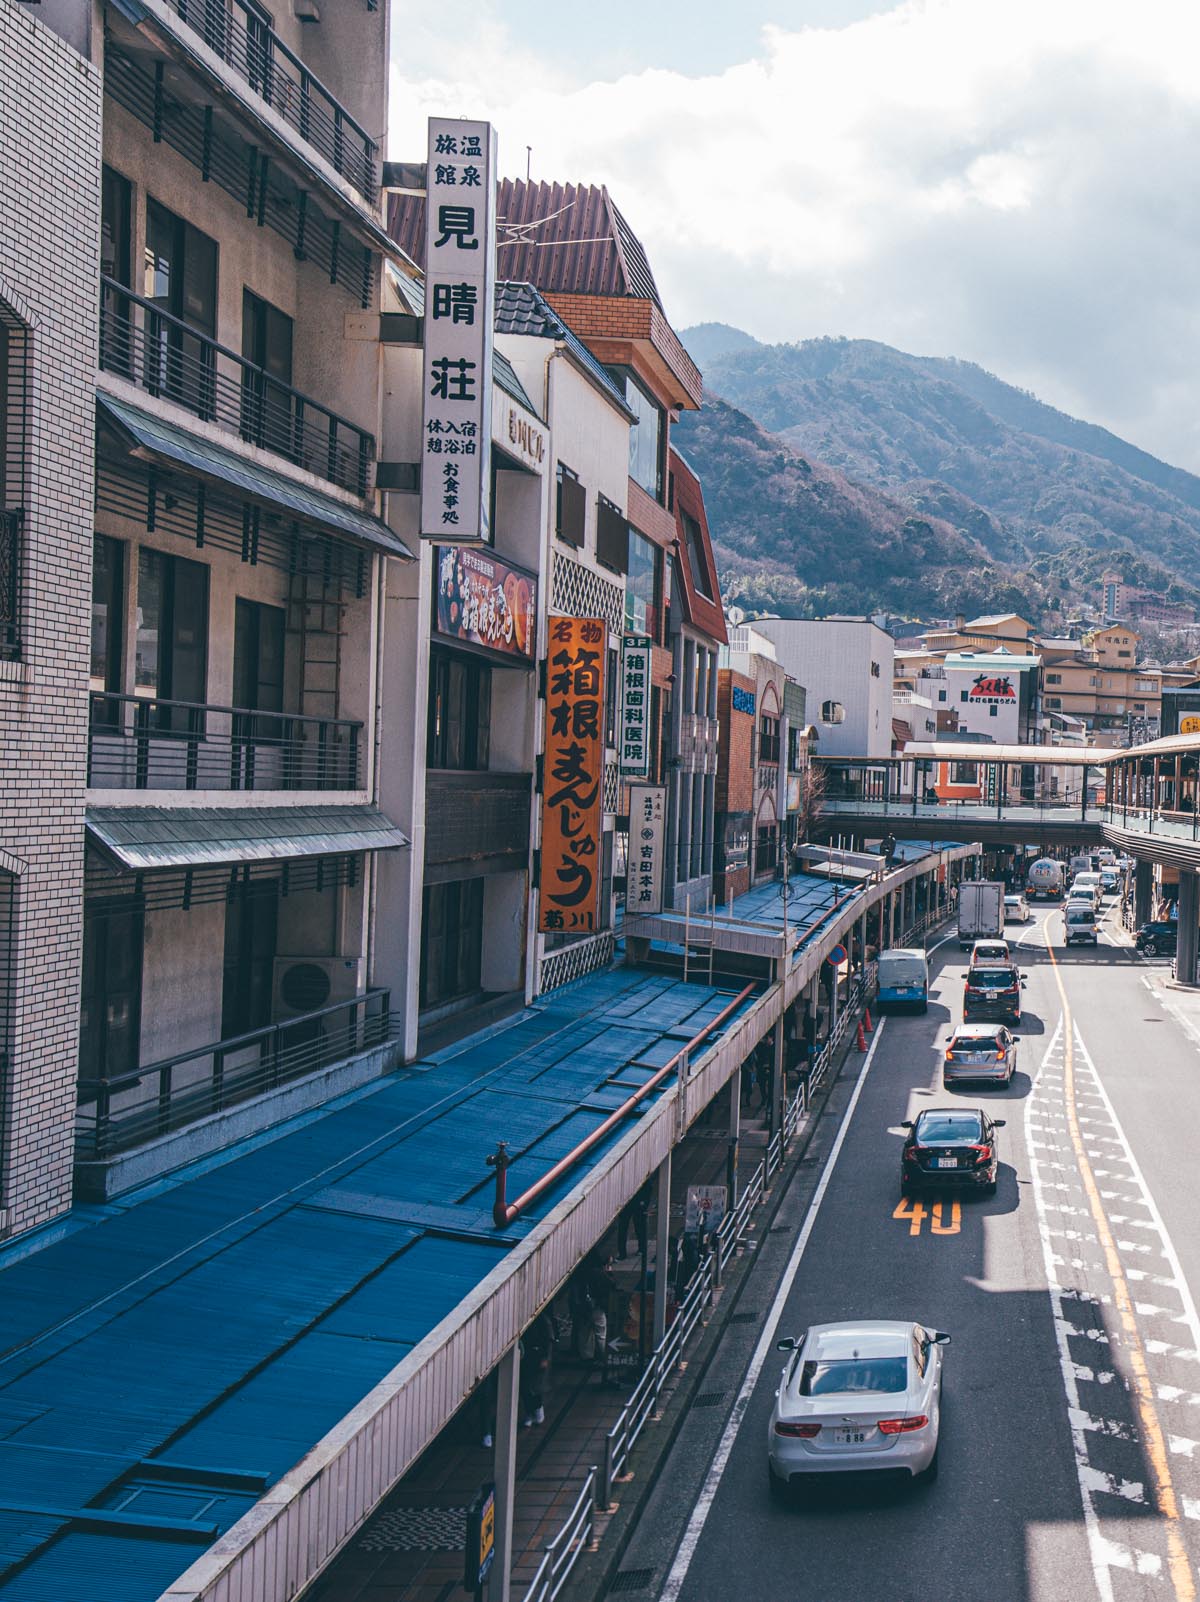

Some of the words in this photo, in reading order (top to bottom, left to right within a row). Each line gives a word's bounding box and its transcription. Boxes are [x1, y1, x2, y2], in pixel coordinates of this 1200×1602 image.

[434, 134, 458, 185] 旅館
[460, 135, 482, 187] 温泉
[430, 205, 479, 402] 見晴荘
[426, 418, 444, 454] 休憩
[443, 420, 461, 455] 入浴
[460, 420, 477, 455] 宿泊
[441, 461, 460, 525] お食事処
[551, 620, 602, 644] 名物
[626, 638, 646, 647] 3F
[624, 654, 645, 760] 箱根歯科医院
[545, 647, 601, 907] 箱根まんじゅう
[638, 845, 654, 903] 吉田本店
[543, 909, 593, 931] 菊川
[892, 1196, 962, 1236] 40
